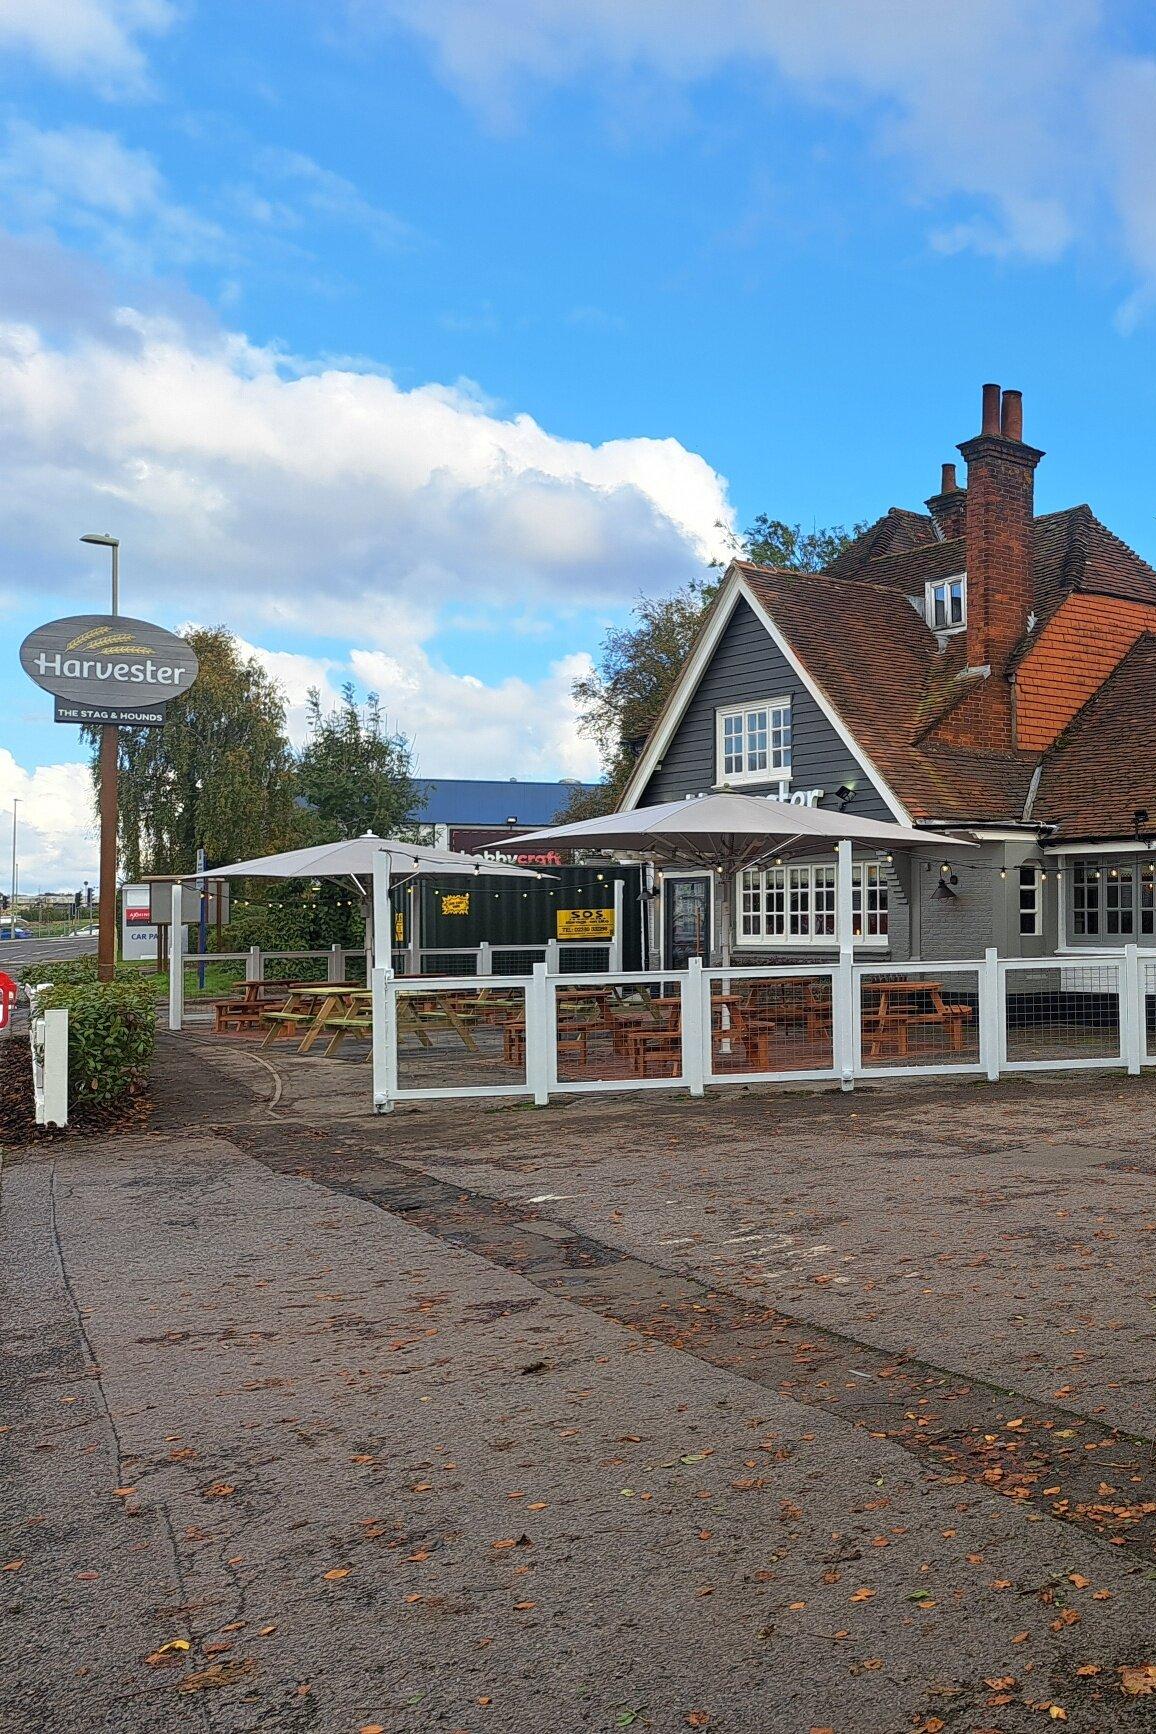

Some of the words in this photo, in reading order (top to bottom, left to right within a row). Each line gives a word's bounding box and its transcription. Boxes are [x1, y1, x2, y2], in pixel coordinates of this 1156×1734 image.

[33, 652, 186, 685] Harvester
[58, 708, 79, 718] THE
[80, 709, 109, 720] STAG
[110, 711, 118, 720] &
[120, 712, 163, 722] HOUNDS
[131, 933, 147, 941] CAR
